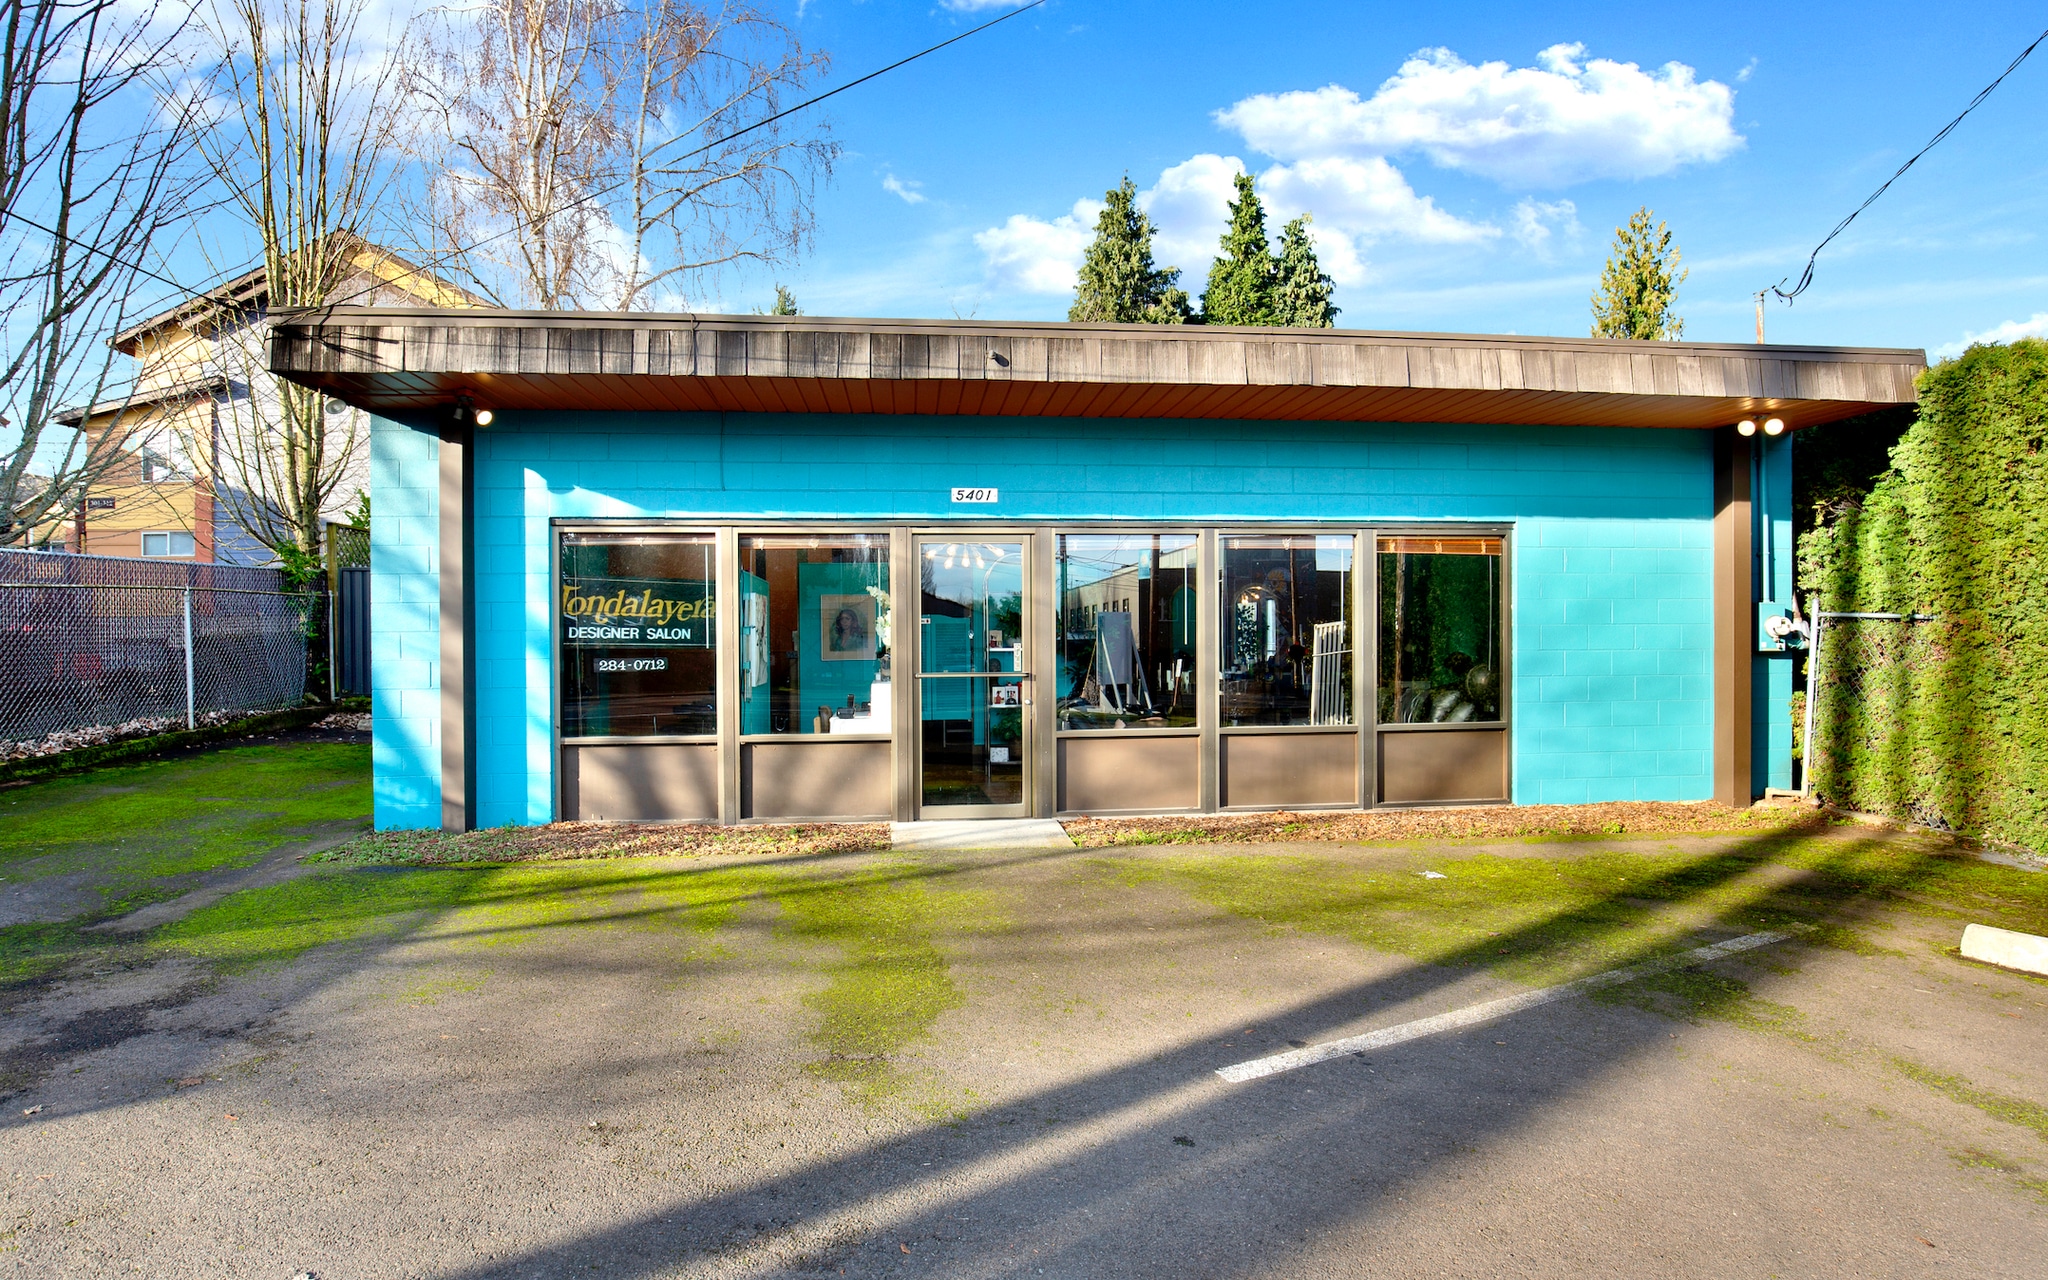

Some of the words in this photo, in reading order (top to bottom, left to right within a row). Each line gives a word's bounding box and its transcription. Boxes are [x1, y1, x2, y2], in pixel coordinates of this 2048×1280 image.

[956, 489, 991, 501] 5401
[568, 626, 639, 639] DESIGNER
[646, 628, 691, 640] SALON
[599, 659, 665, 671] 284-0712
